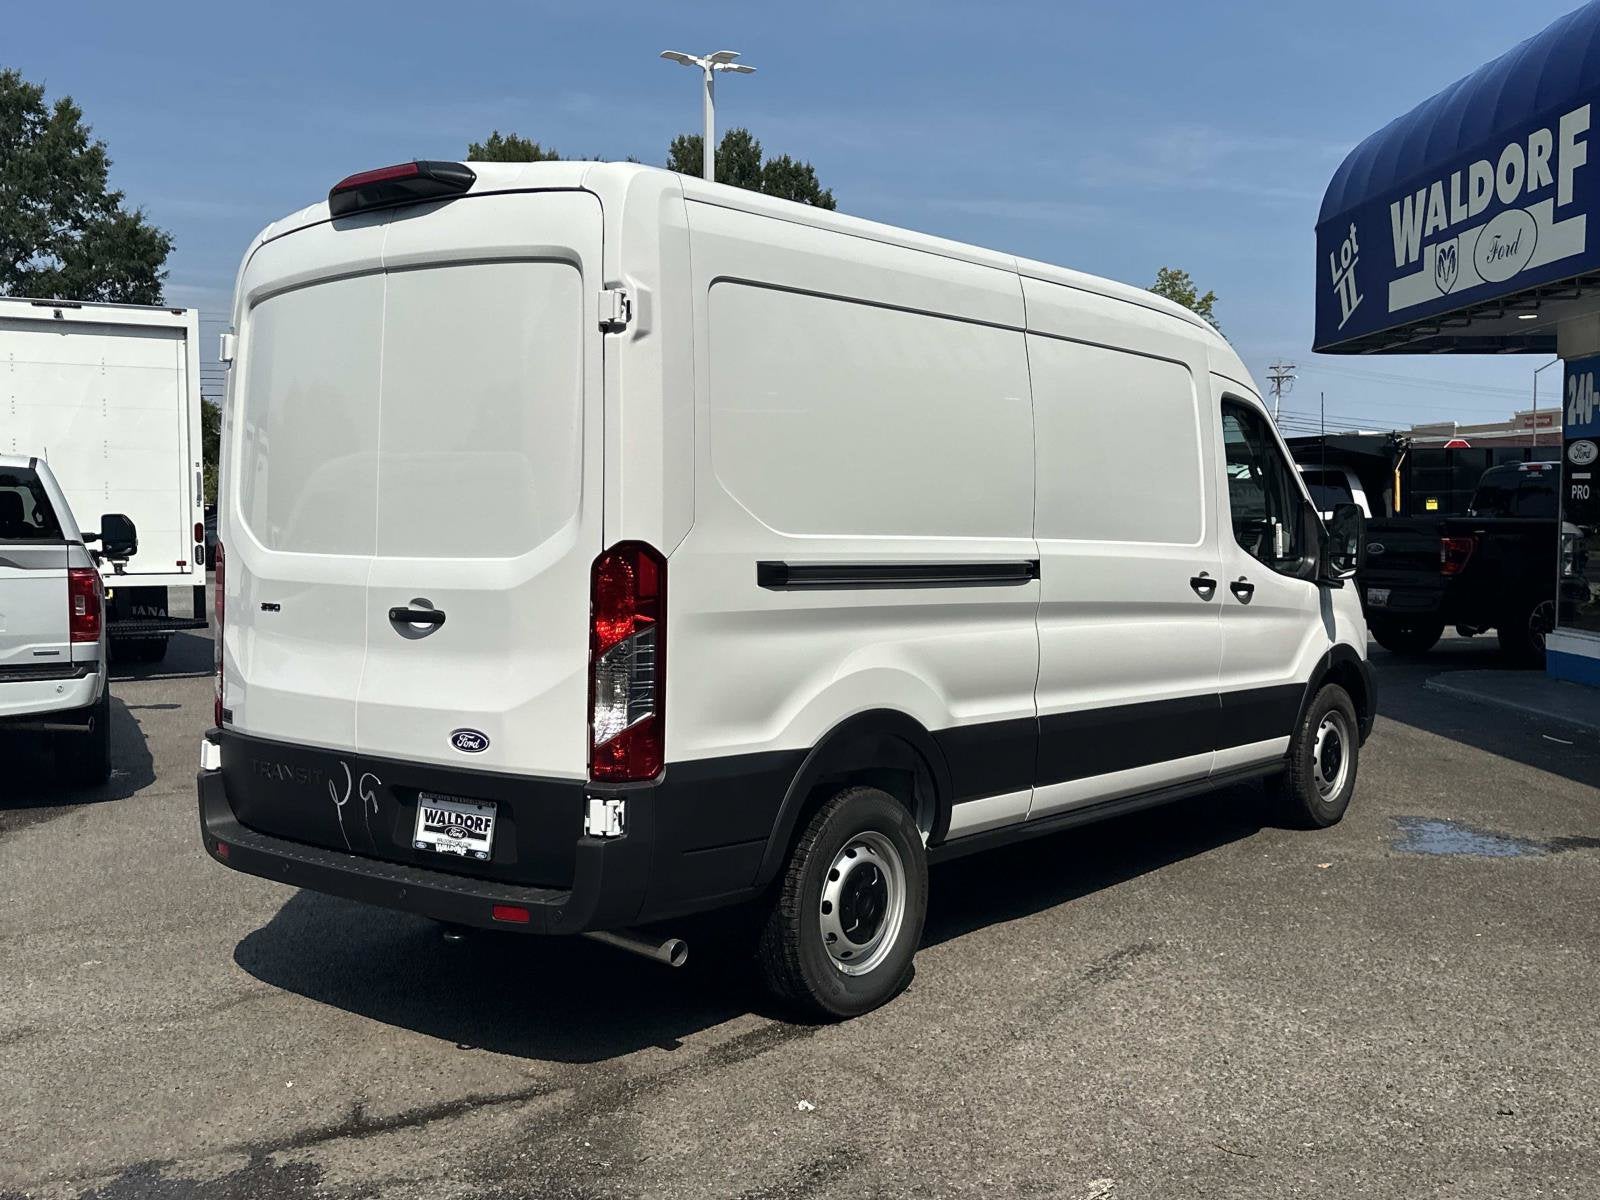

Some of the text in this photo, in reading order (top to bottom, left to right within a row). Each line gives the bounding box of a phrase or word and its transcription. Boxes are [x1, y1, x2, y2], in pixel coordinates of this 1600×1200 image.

[1390, 103, 1591, 268] WALDORF
[1330, 222, 1359, 286] Lot
[1486, 228, 1523, 264] Ford
[1334, 256, 1364, 330] II
[1567, 371, 1600, 426] 240-
[1574, 443, 1591, 460] Ford
[1571, 484, 1590, 500] PRO
[456, 733, 481, 749] Ford
[248, 759, 328, 785] TRANSIT
[424, 808, 492, 832] WALDORF
[448, 827, 464, 838] Ford
